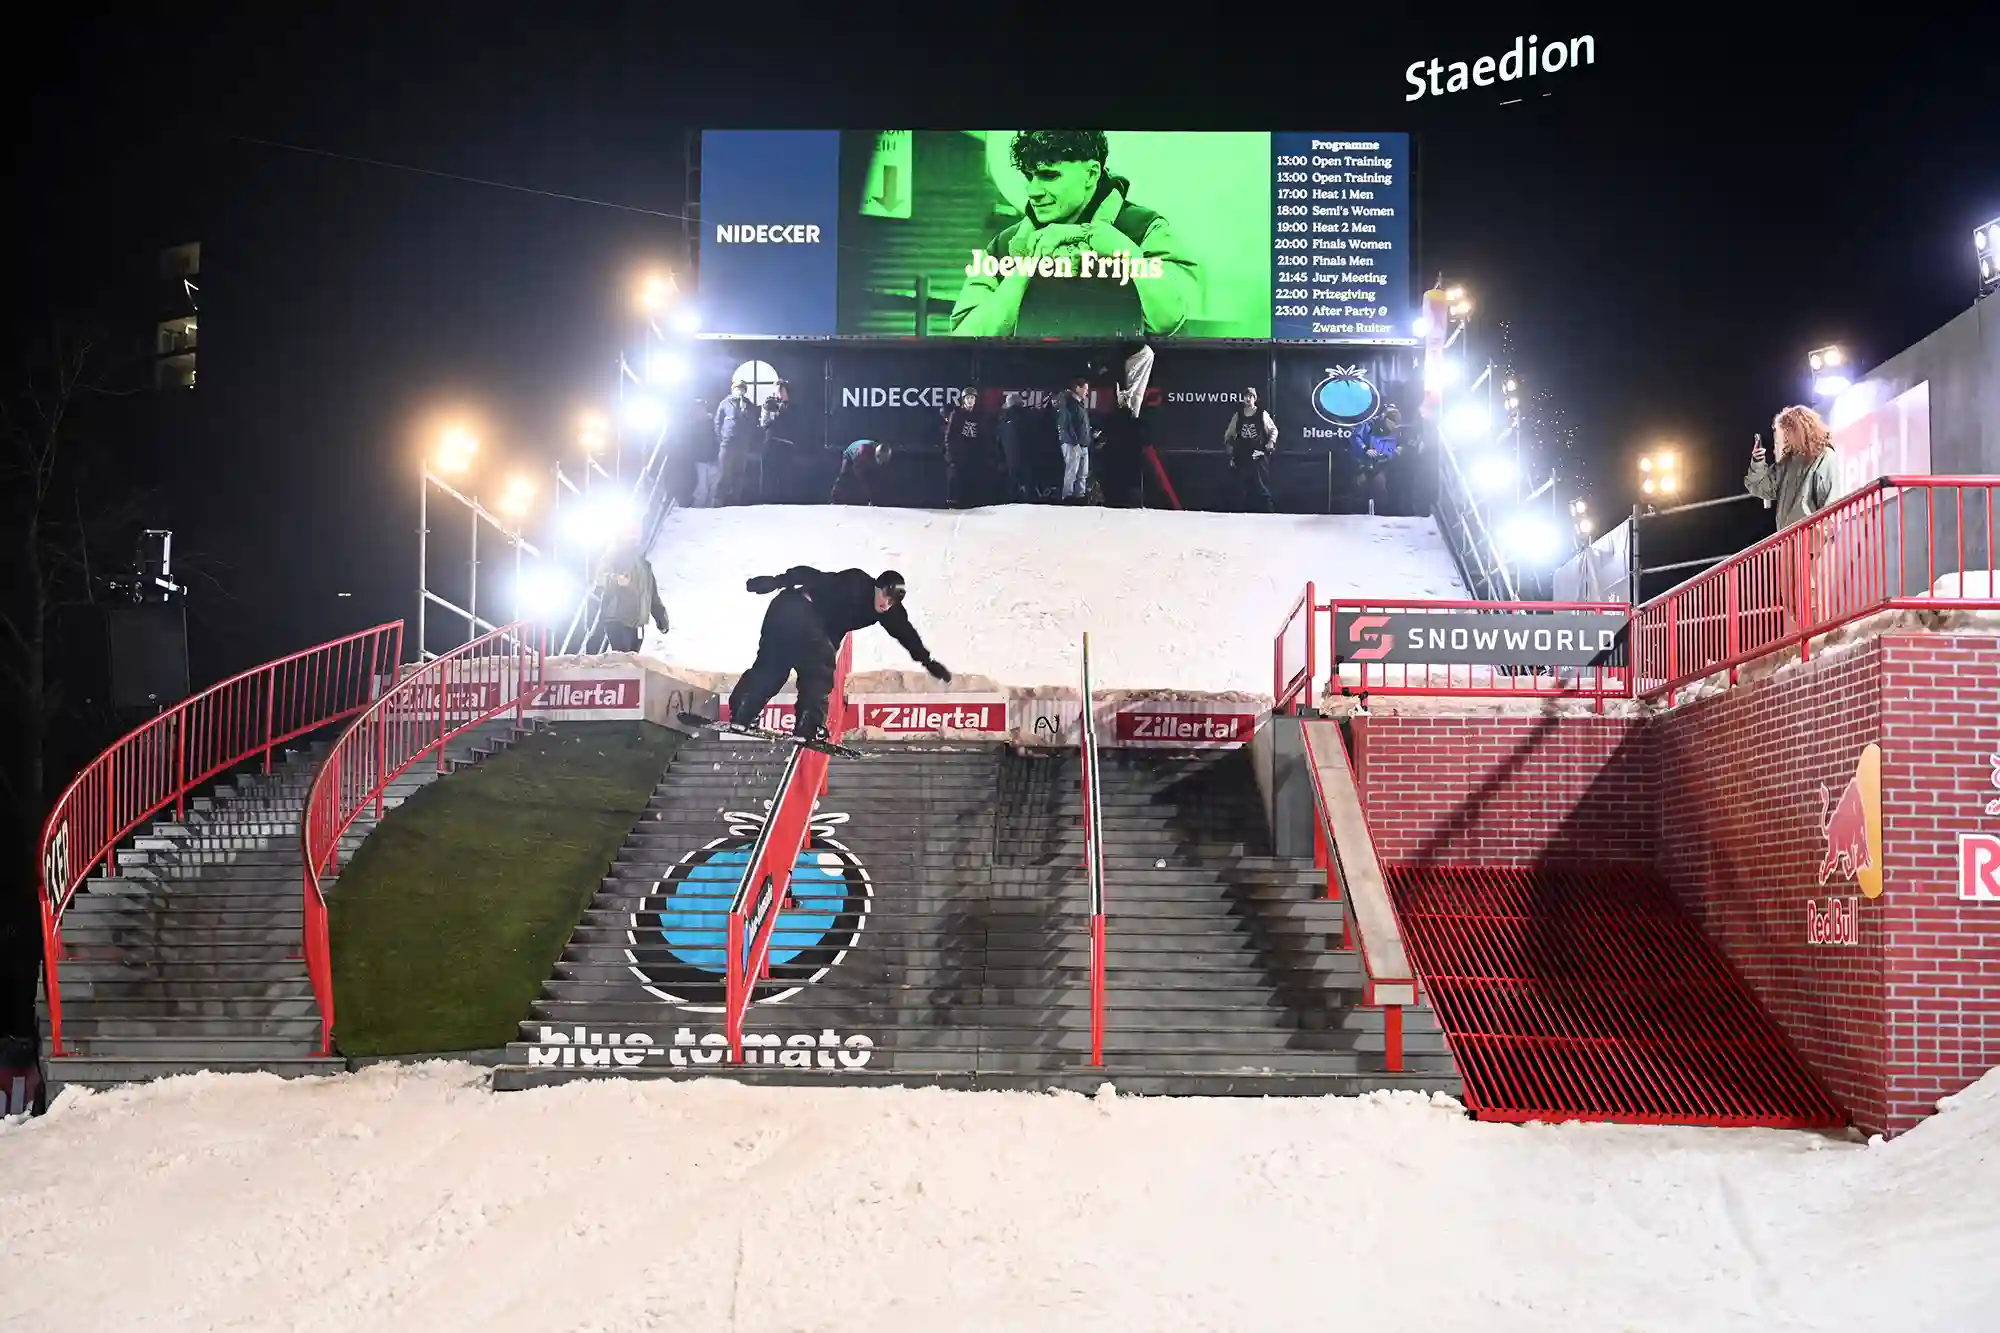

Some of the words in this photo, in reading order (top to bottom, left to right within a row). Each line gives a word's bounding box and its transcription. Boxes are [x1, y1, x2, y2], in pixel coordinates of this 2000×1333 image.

[1405, 34, 1595, 102] Staedion
[1311, 139, 1380, 151] Programme
[1277, 156, 1308, 167] 13:00
[1312, 156, 1342, 168] Open
[1344, 156, 1393, 169] Training
[1277, 172, 1308, 183] 13:00
[1312, 172, 1342, 184] Open
[1344, 172, 1393, 185] Training
[1277, 189, 1308, 200] 17:00
[1312, 189, 1339, 200] Heat
[1341, 189, 1347, 200] 1
[1349, 189, 1374, 200] Men
[1277, 205, 1308, 216] 18:00
[1312, 205, 1349, 216] Semi's
[1351, 206, 1395, 216] Women
[716, 224, 820, 243] NIDECKER
[1277, 222, 1308, 233] 19:00
[1312, 222, 1339, 233] Heat
[1341, 222, 1349, 233] 2
[1351, 222, 1376, 233] Men
[1274, 239, 1308, 250] 20:00
[1312, 239, 1346, 250] Finals
[1349, 239, 1392, 250] Women
[1277, 255, 1308, 266] 21:00
[1312, 255, 1346, 266] Finals
[1349, 255, 1374, 266] Men
[965, 249, 1074, 278] Joewen
[1080, 250, 1164, 286] Frijns
[1278, 272, 1308, 283] 21:45
[1312, 272, 1339, 285] Jury
[1341, 272, 1387, 285] Meeting
[1275, 289, 1308, 300] 22:00
[1312, 289, 1376, 301] Prizegiving
[1275, 305, 1308, 316] 23:00
[1312, 305, 1342, 316] After
[1344, 305, 1376, 318] Party
[1312, 322, 1353, 333] Zwarte
[1356, 322, 1393, 333] Ruiter
[842, 387, 962, 408] NIDECKER
[1168, 392, 1245, 403] SNOWWORL
[1303, 427, 1352, 439] blue-to
[1408, 628, 1616, 651] SNOWWORLD
[531, 683, 625, 706] Zillertal
[881, 706, 989, 729] Zillertal
[1133, 716, 1238, 738] Zillertal
[1806, 897, 1832, 944] Red
[1832, 897, 1859, 945] Bull
[528, 1026, 875, 1068] blue-tomato
